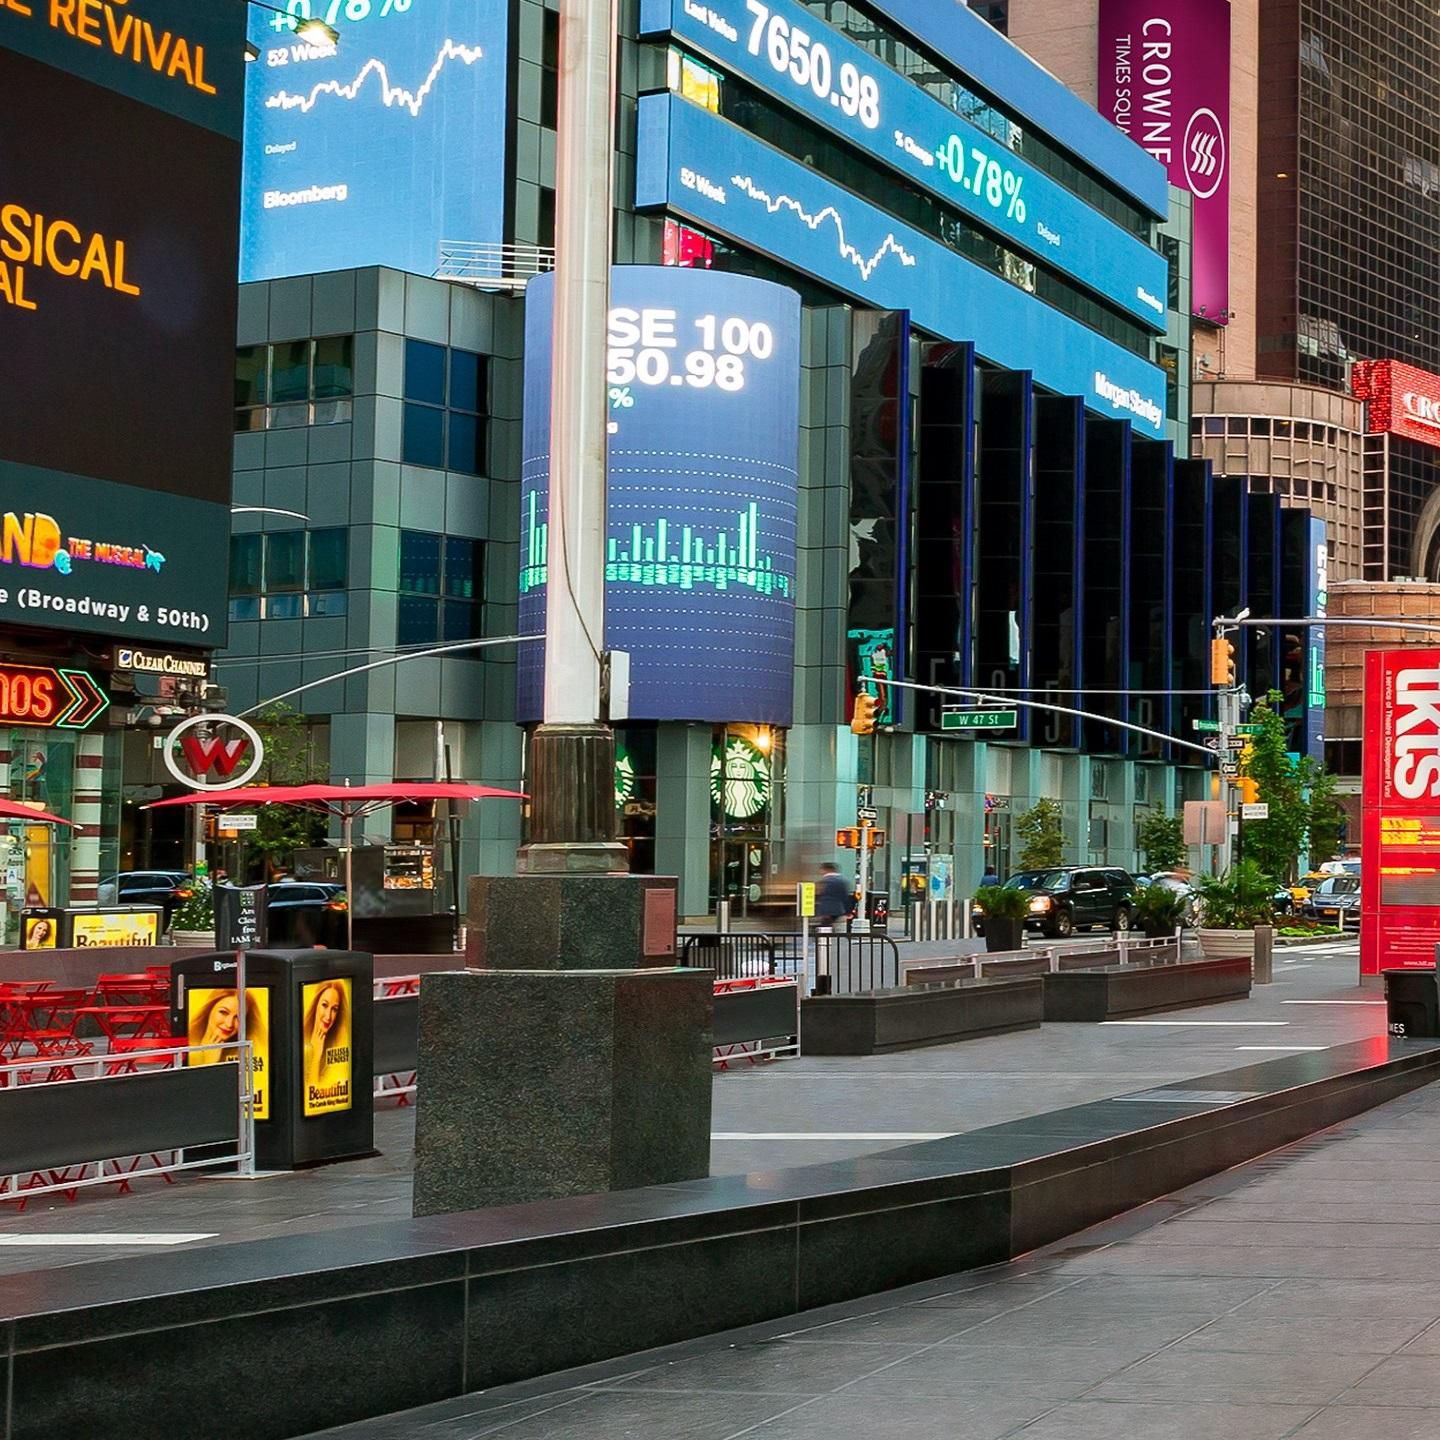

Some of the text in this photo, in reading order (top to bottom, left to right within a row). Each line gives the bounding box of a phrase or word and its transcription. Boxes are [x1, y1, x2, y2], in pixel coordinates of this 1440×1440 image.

[268, 41, 337, 67] 52 Week
[1115, 34, 1131, 84] TIMES
[263, 182, 347, 210] Bloomberg
[680, 167, 727, 205] 52 Week
[936, 134, 1026, 224] +0.78%
[0, 204, 140, 296] SICAL
[694, 314, 772, 360] 100
[608, 387, 634, 408] %
[1095, 371, 1162, 429] Morgan Stanley
[68, 537, 92, 559] THE
[94, 542, 145, 569] MUSICAL
[18, 589, 130, 622] (Broadway
[136, 605, 150, 622] &
[157, 607, 209, 631] 50th)
[960, 715, 999, 725] W 47 St
[1384, 737, 1392, 780] Development
[1384, 781, 1392, 798] Fund
[308, 1080, 349, 1101] Beautiful
